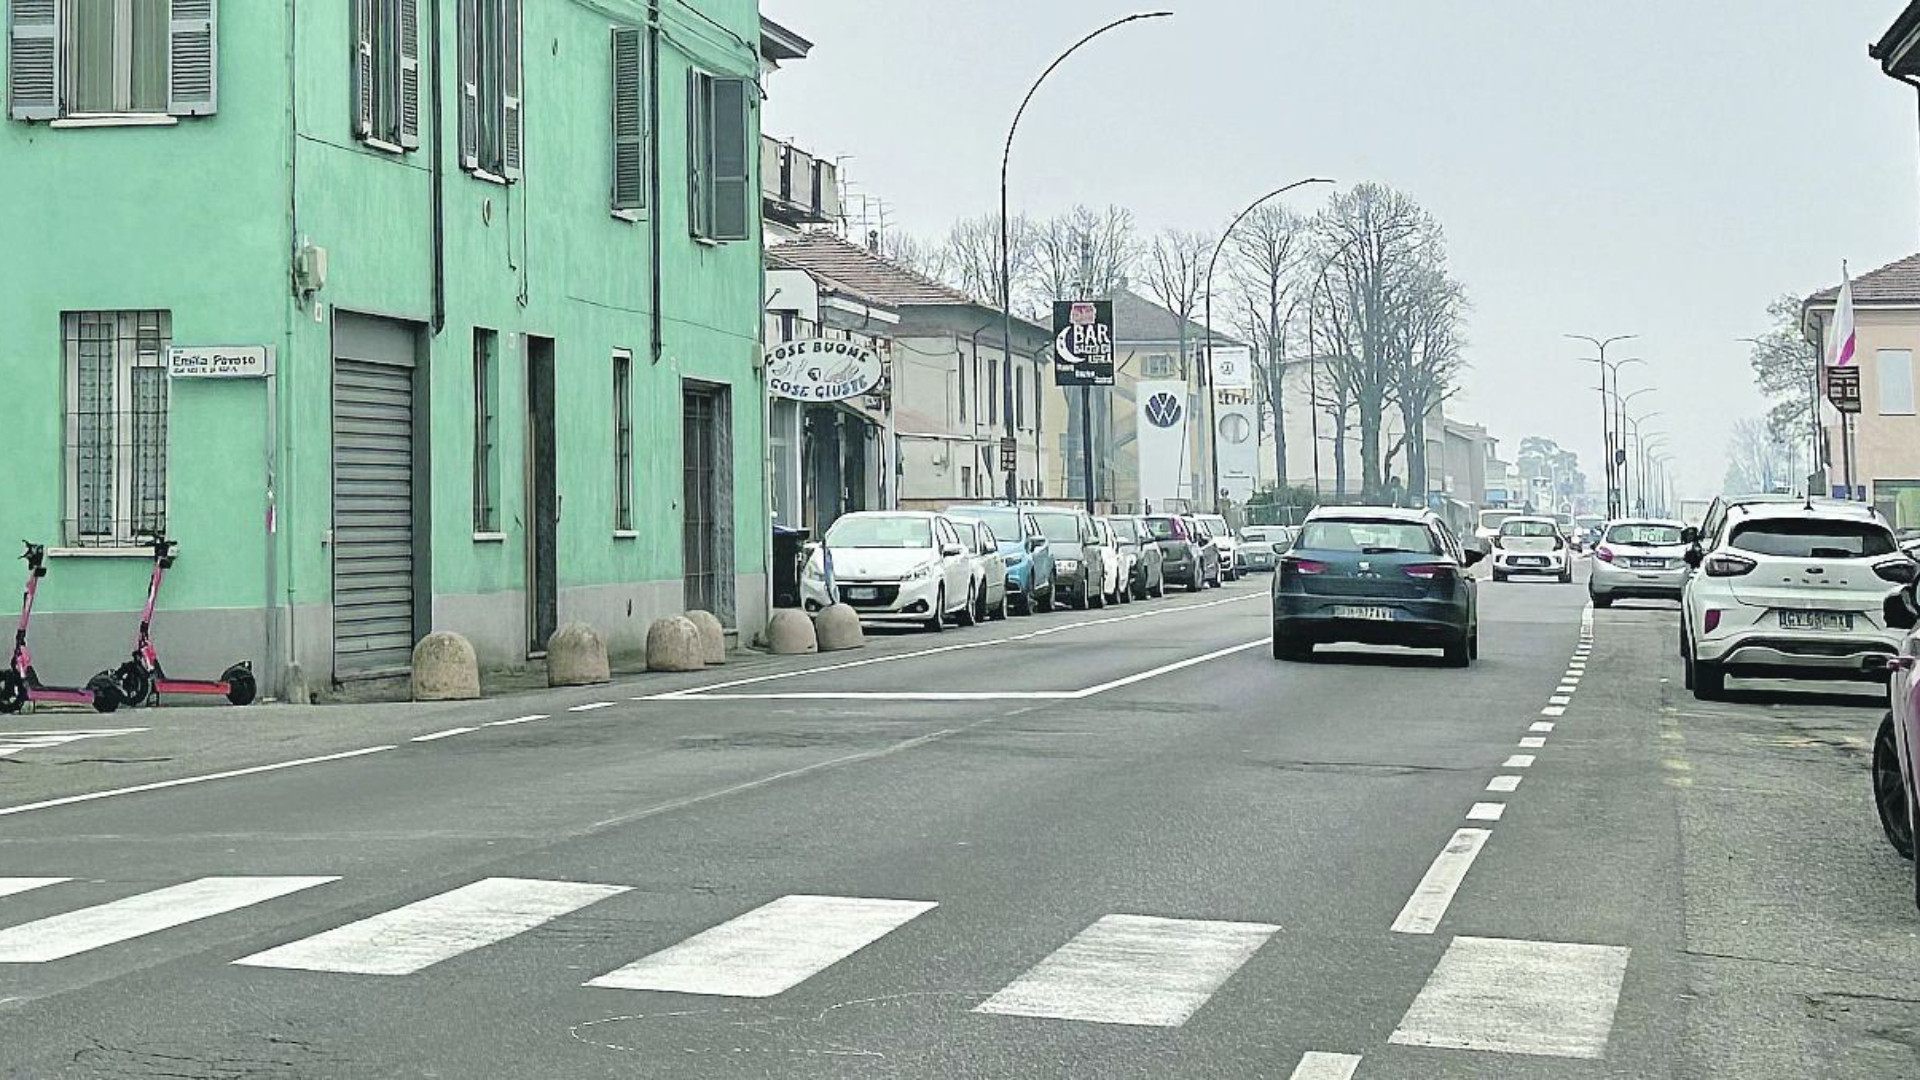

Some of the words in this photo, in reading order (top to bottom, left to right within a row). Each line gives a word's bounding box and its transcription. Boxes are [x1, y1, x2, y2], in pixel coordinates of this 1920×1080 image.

[1073, 323, 1111, 346] BAR
[765, 342, 805, 366] COSE
[813, 342, 870, 362] BUONE
[771, 379, 810, 397] COSE
[815, 374, 868, 398] GIUSTE
